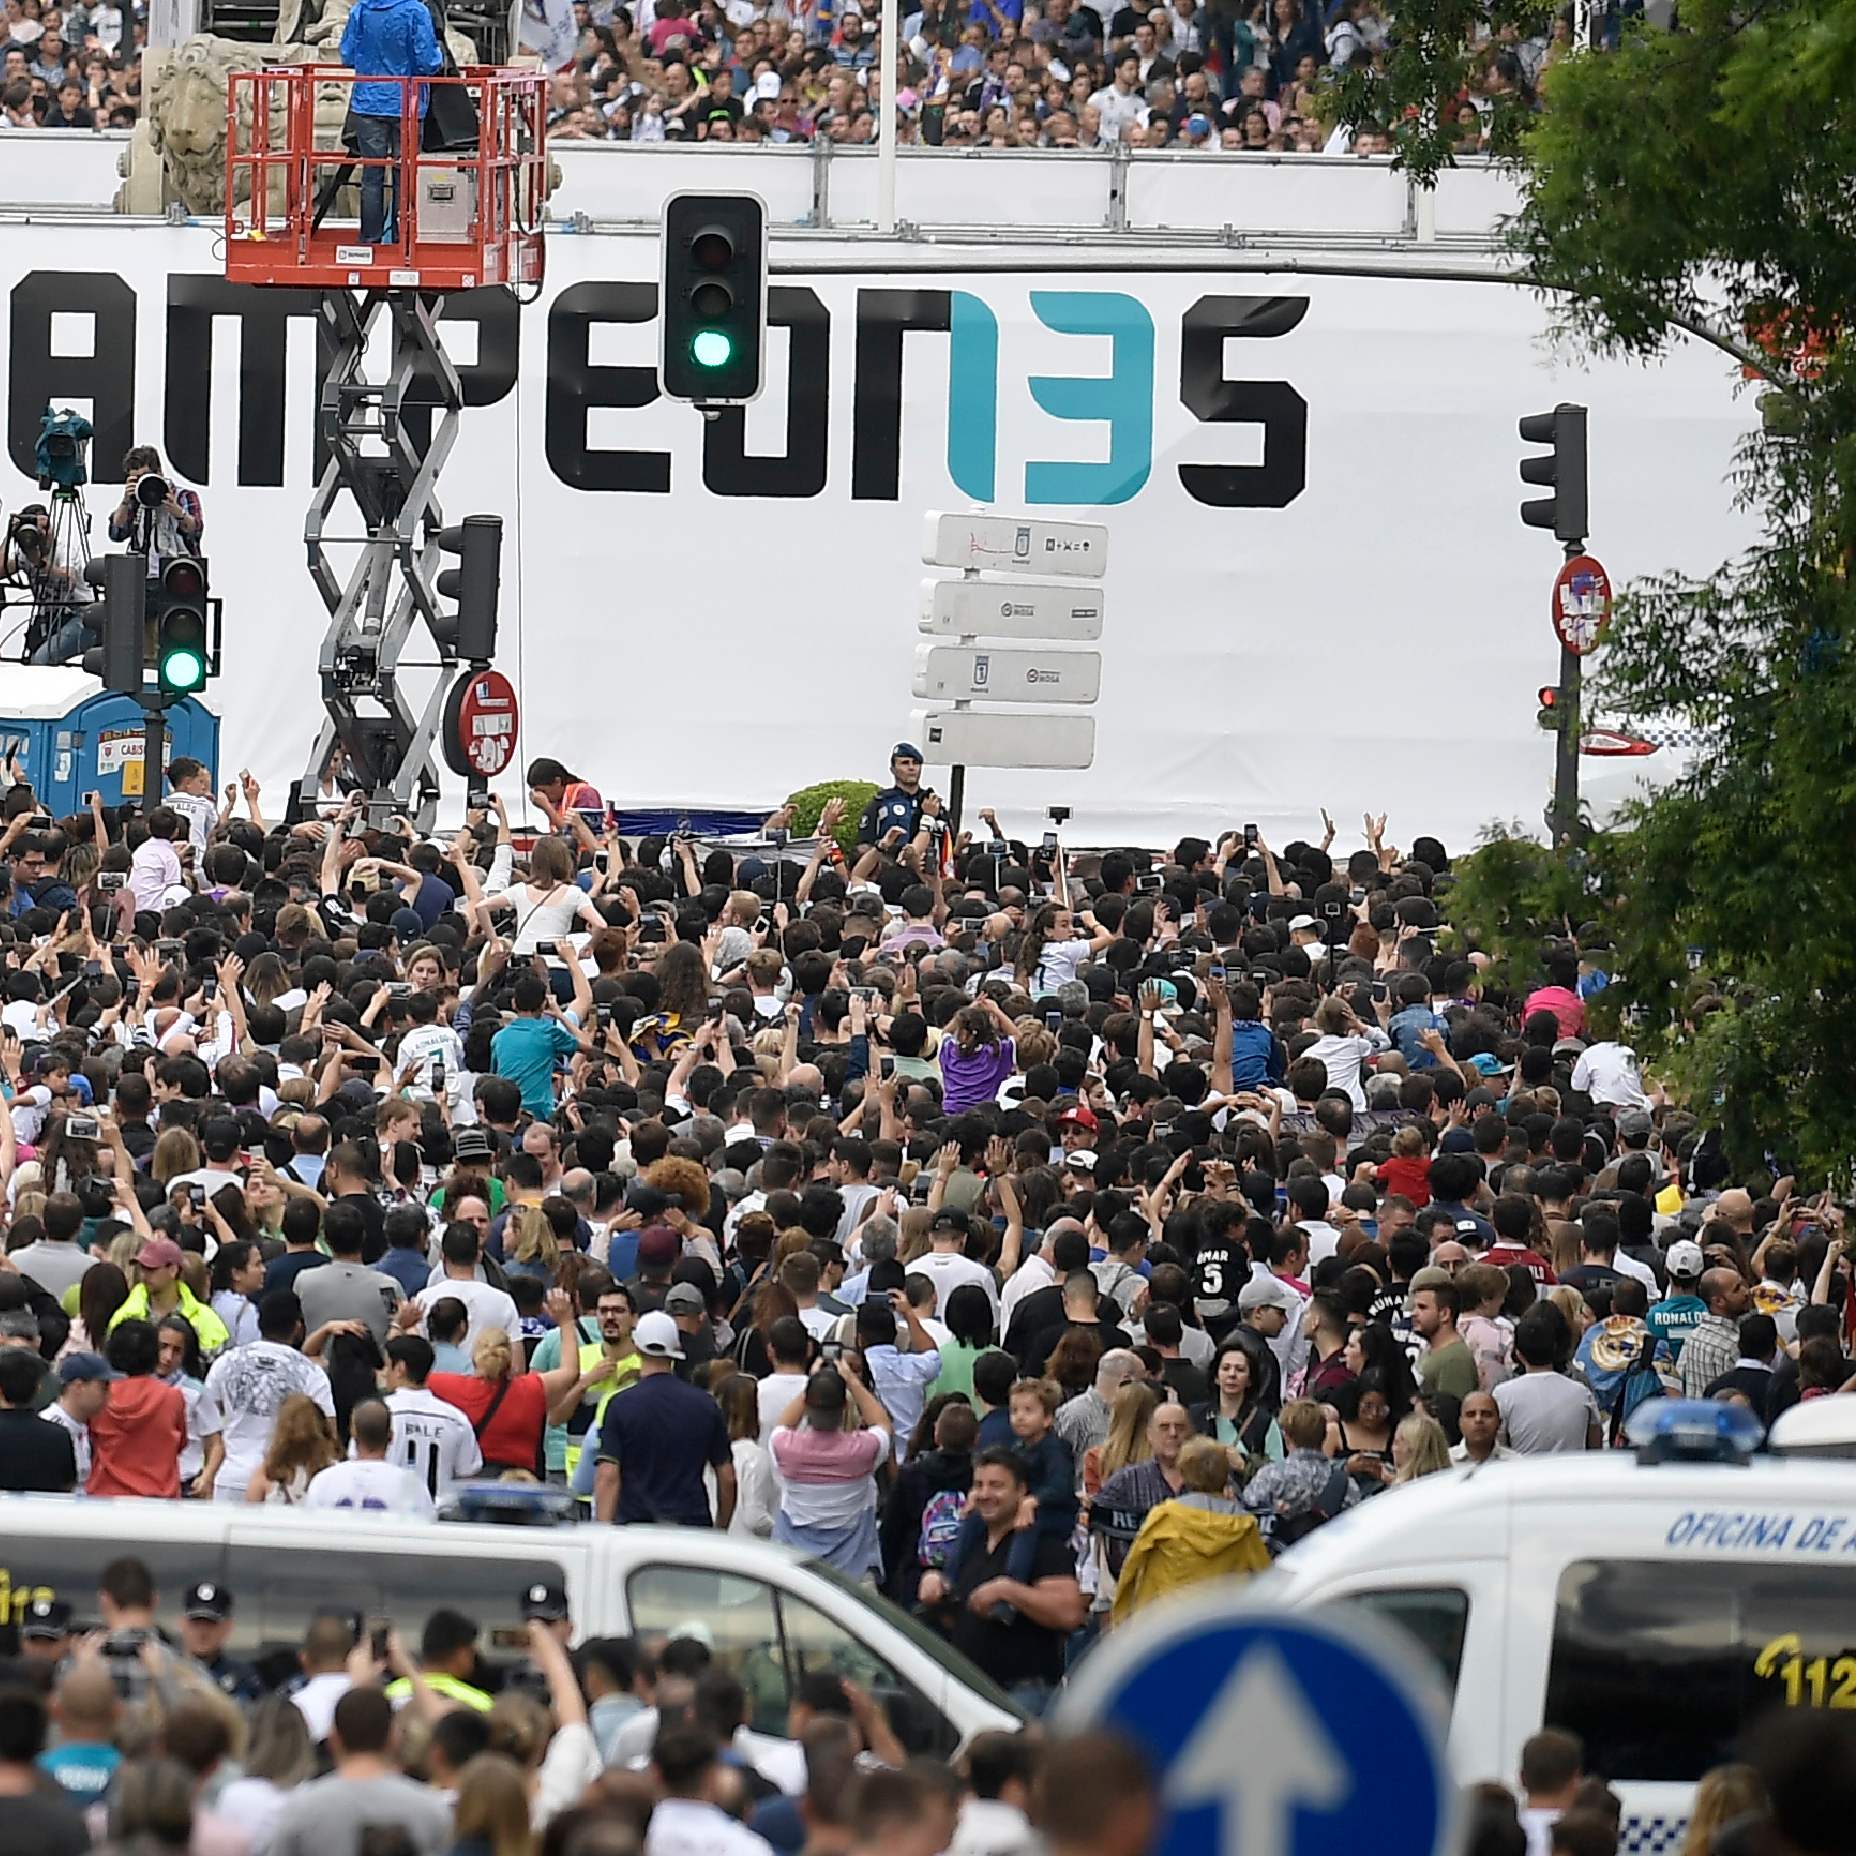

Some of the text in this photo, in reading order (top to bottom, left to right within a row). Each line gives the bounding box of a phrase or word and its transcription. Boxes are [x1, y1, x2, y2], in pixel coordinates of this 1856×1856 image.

[120, 742, 145, 757] CABIS
[1201, 1263, 1223, 1294] 5
[404, 1422, 444, 1439] BALE
[1665, 1511, 1848, 1552] OFICINA DE
[1780, 1655, 1856, 1710] 112
